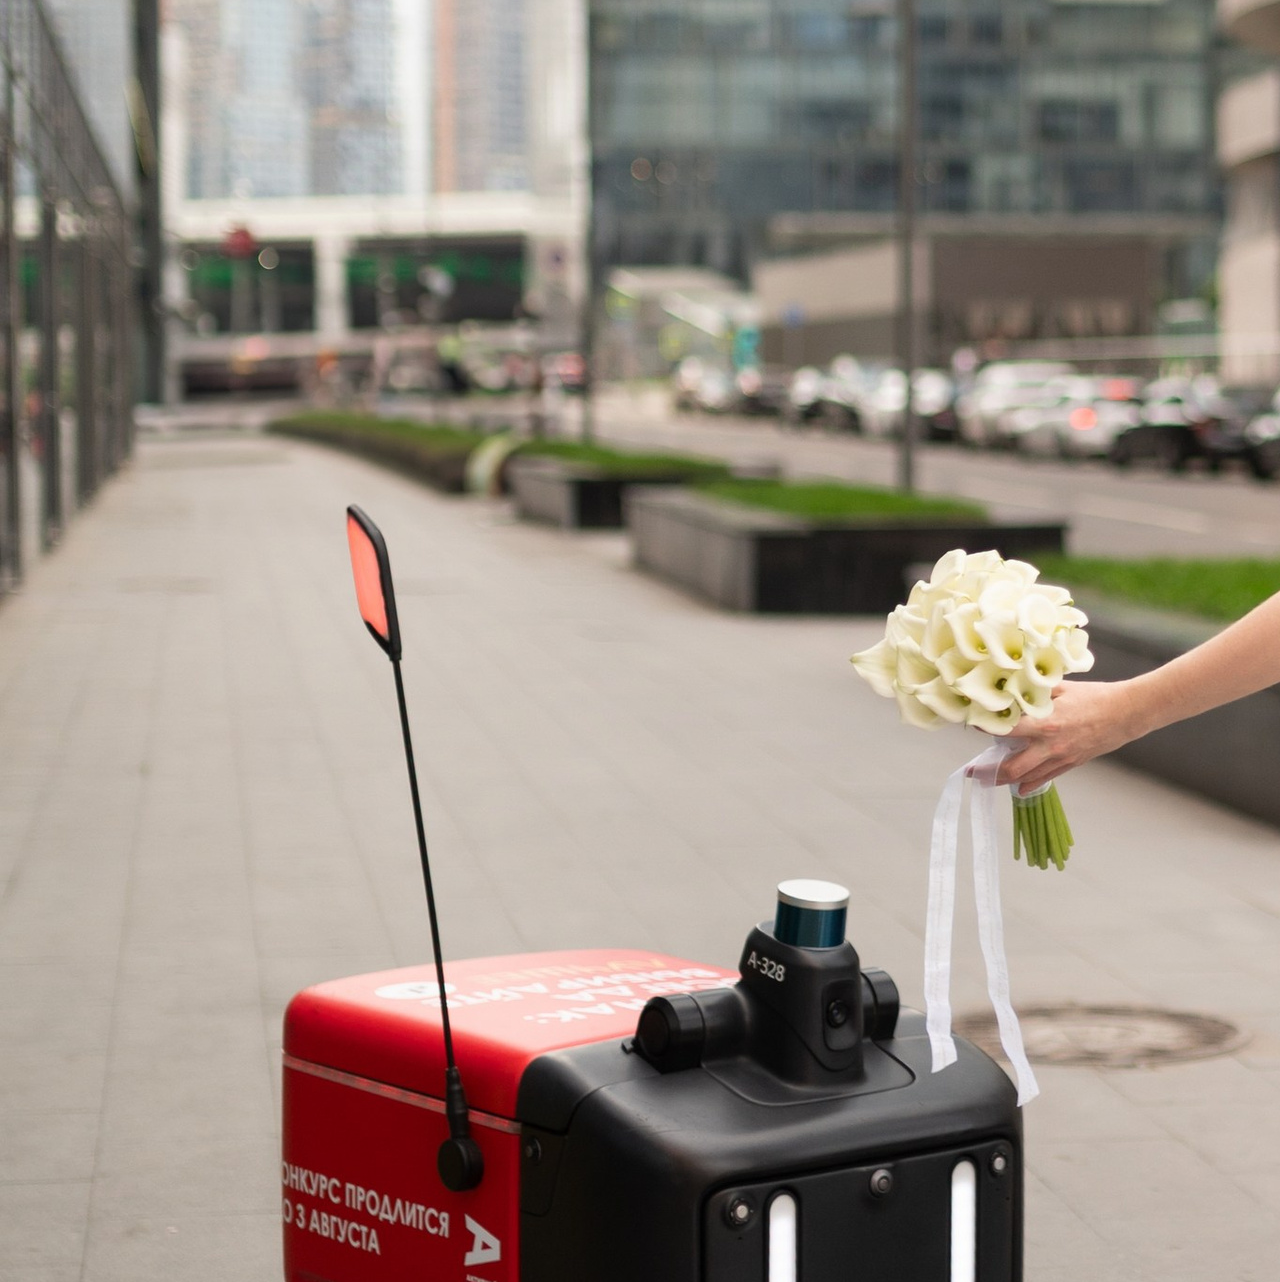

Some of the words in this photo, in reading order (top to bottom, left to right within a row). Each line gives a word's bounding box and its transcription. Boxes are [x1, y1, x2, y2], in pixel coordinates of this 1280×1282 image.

[747, 950, 786, 982] A-328
[522, 998, 647, 1024] НАК:
[282, 1160, 342, 1204] ОНКУРС
[344, 1181, 451, 1240] ПРОДЛИТСЯ
[295, 1202, 306, 1230] 3
[308, 1207, 382, 1256] АВГУСТА
